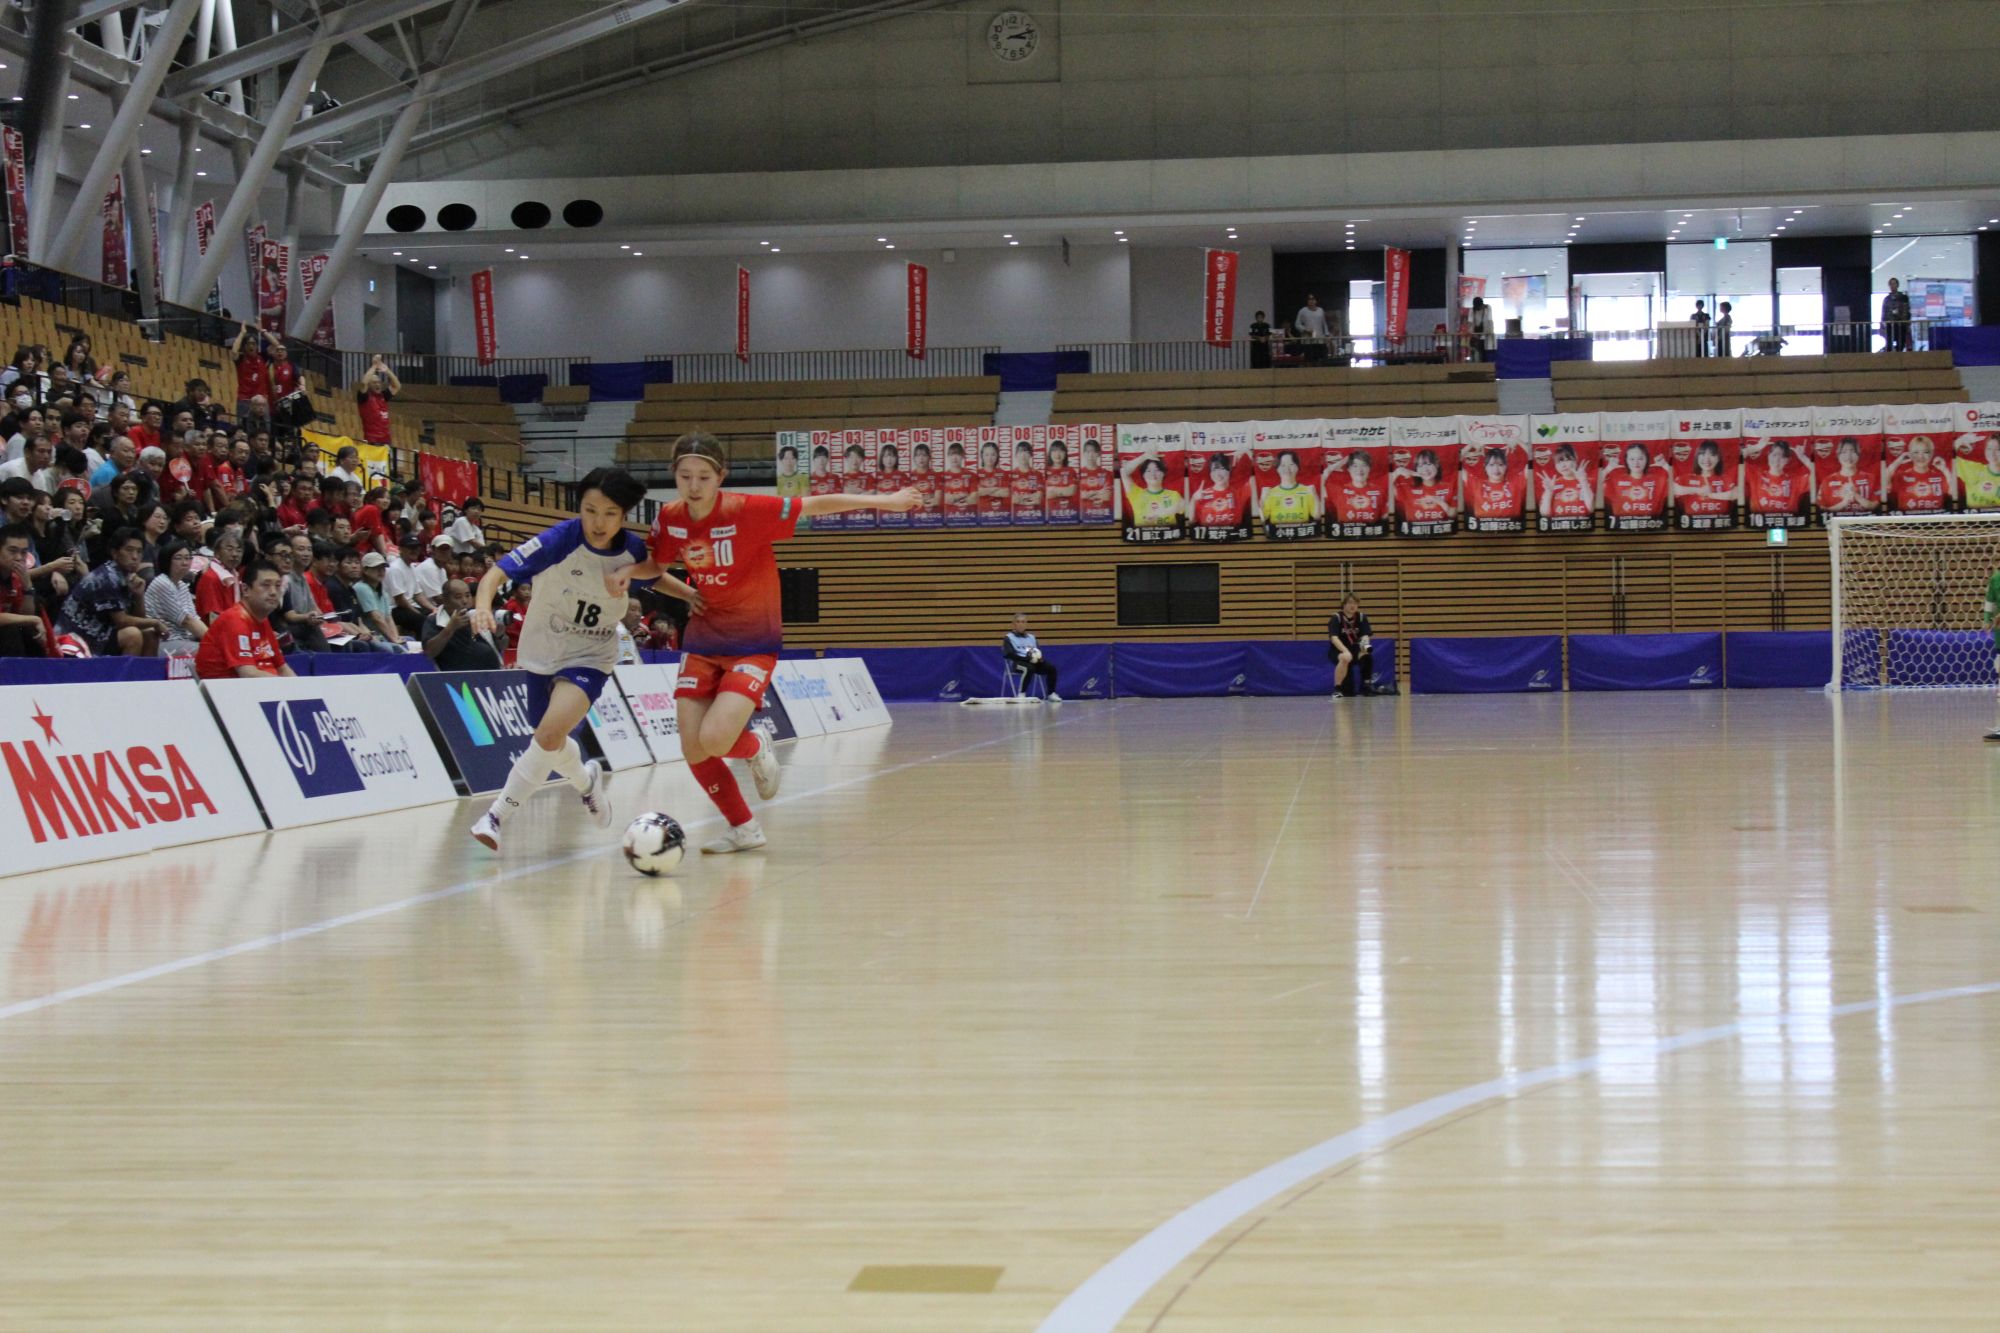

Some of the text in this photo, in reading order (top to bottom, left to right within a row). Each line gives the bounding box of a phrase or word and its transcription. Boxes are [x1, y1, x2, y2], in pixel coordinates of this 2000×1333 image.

[263, 244, 278, 259] 23
[780, 432, 795, 445] 01
[812, 432, 828, 445] 02
[846, 431, 862, 444] 03
[880, 430, 895, 444] 04
[913, 430, 929, 442] 05
[946, 428, 962, 442] 06
[982, 428, 996, 441] 07
[1015, 427, 1031, 440] 08
[1050, 426, 1065, 440] 09
[1084, 426, 1098, 439] 10
[1701, 502, 1720, 510] FBC
[1468, 517, 1478, 530] 5
[1540, 518, 1548, 532] 6
[1609, 516, 1616, 529] 7
[1680, 514, 1690, 528] 9
[1750, 514, 1763, 527] 10
[1126, 527, 1140, 540] 21
[1194, 526, 1206, 540] 17
[1332, 523, 1341, 537] 3
[712, 540, 734, 567] 10
[574, 600, 602, 628] 18
[312, 710, 366, 743] ABeam
[350, 740, 418, 779] Consulting
[0, 740, 218, 844] MIKASA
